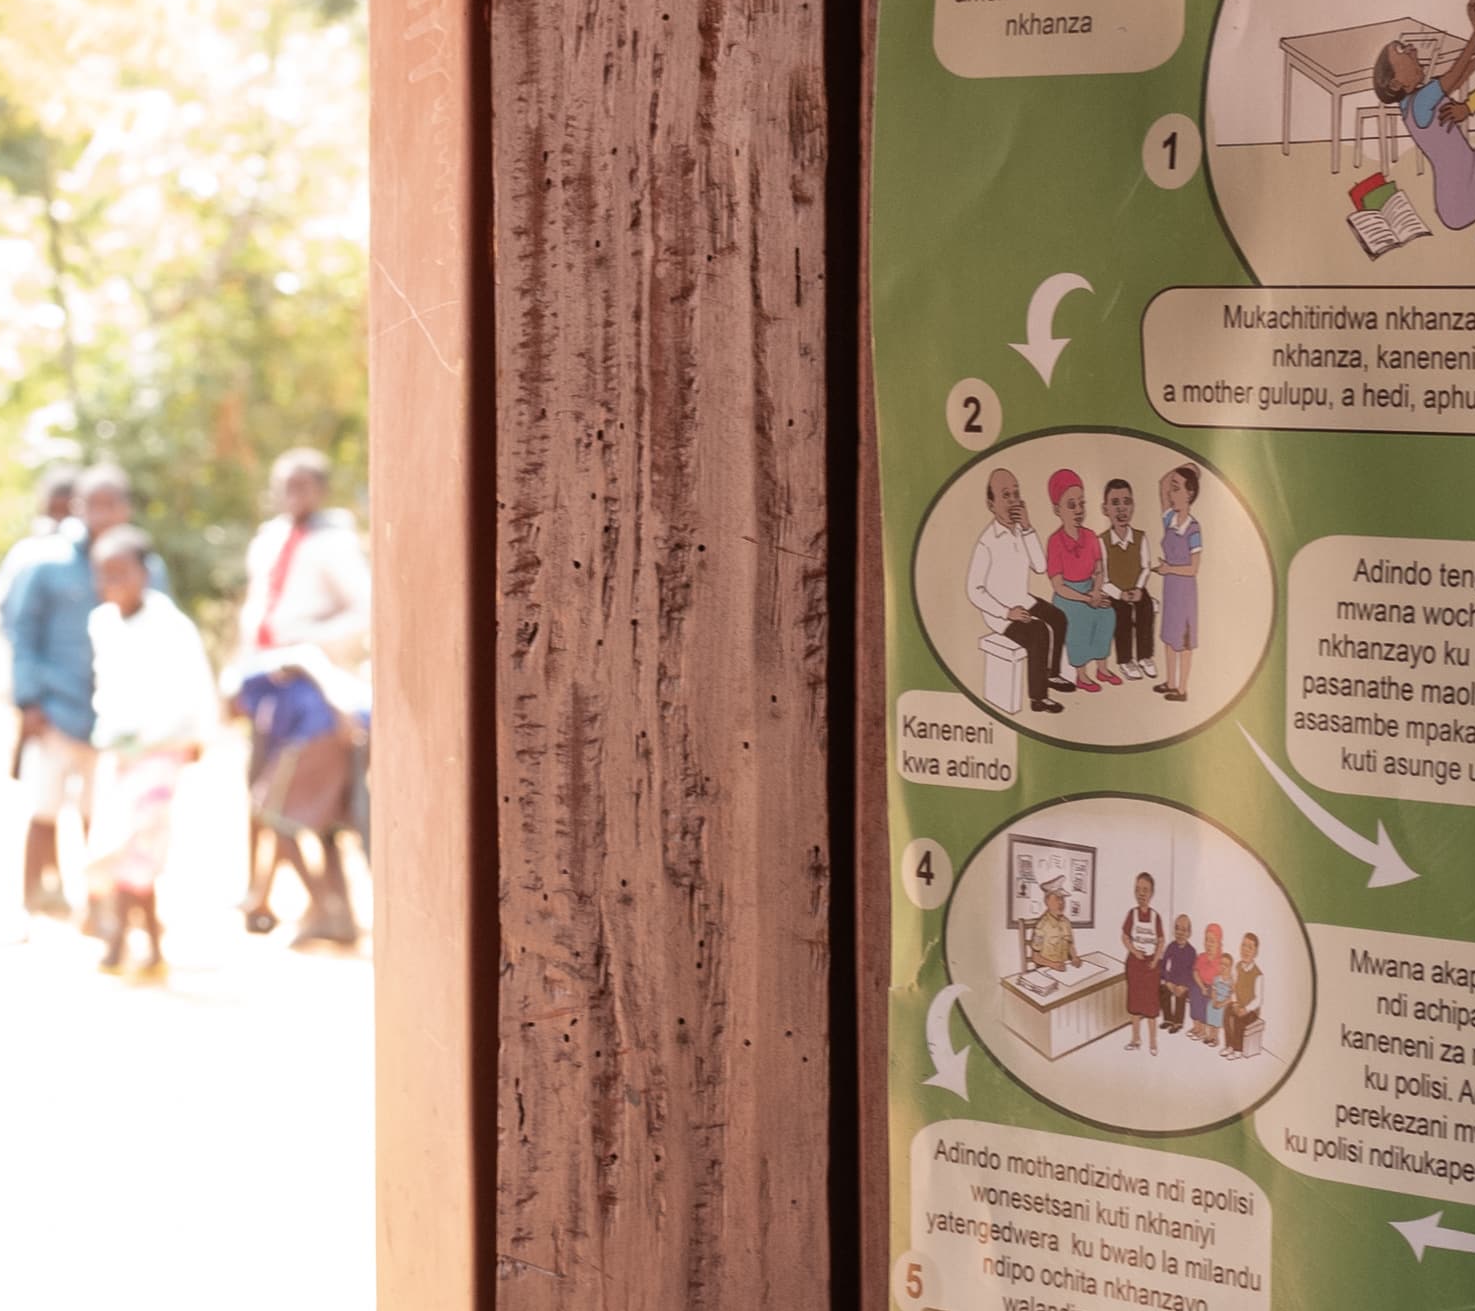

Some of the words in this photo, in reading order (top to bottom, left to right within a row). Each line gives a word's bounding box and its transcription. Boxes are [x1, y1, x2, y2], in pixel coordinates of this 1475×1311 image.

[1006, 13, 1092, 36] nkhanza
[1161, 131, 1178, 170] 1
[1224, 305, 1378, 330] Mukachitiridwa
[1273, 344, 1368, 372] nkhanza,
[1377, 344, 1475, 370] kaneneni
[1164, 384, 1176, 402] a
[1182, 380, 1253, 404] mother
[1258, 381, 1333, 411] gulupu,
[1342, 388, 1354, 406] a
[1363, 383, 1415, 411] hedi,
[962, 396, 983, 433] 2
[1353, 558, 1432, 586] Adindo
[1338, 601, 1415, 624] mwana
[1319, 634, 1436, 669] nkhanzayo
[1444, 641, 1470, 666] ku
[1303, 675, 1413, 701] pasanathe
[904, 716, 993, 744] Kaneneni
[1294, 712, 1399, 737] asasambe
[903, 750, 940, 775] kwa
[947, 756, 1011, 782] adindo
[1342, 747, 1377, 772] kuti
[1384, 756, 1461, 785] asunge
[916, 849, 935, 886] 4
[1351, 949, 1424, 981] Mwana
[1377, 993, 1408, 1017] ndi
[1342, 1024, 1433, 1059] kaneneni
[1440, 1044, 1465, 1064] za
[1365, 1065, 1388, 1091] ku
[1395, 1073, 1452, 1101] polisi.
[1336, 1105, 1447, 1138] perekezani
[1285, 1128, 1307, 1154] ku
[1314, 1137, 1363, 1163] polisi
[934, 1139, 1001, 1170] Adindo
[1007, 1156, 1150, 1196] mothandizidwa
[1156, 1179, 1184, 1203] ndi
[1192, 1188, 1253, 1215] apolisi
[905, 1262, 924, 1299] 5
